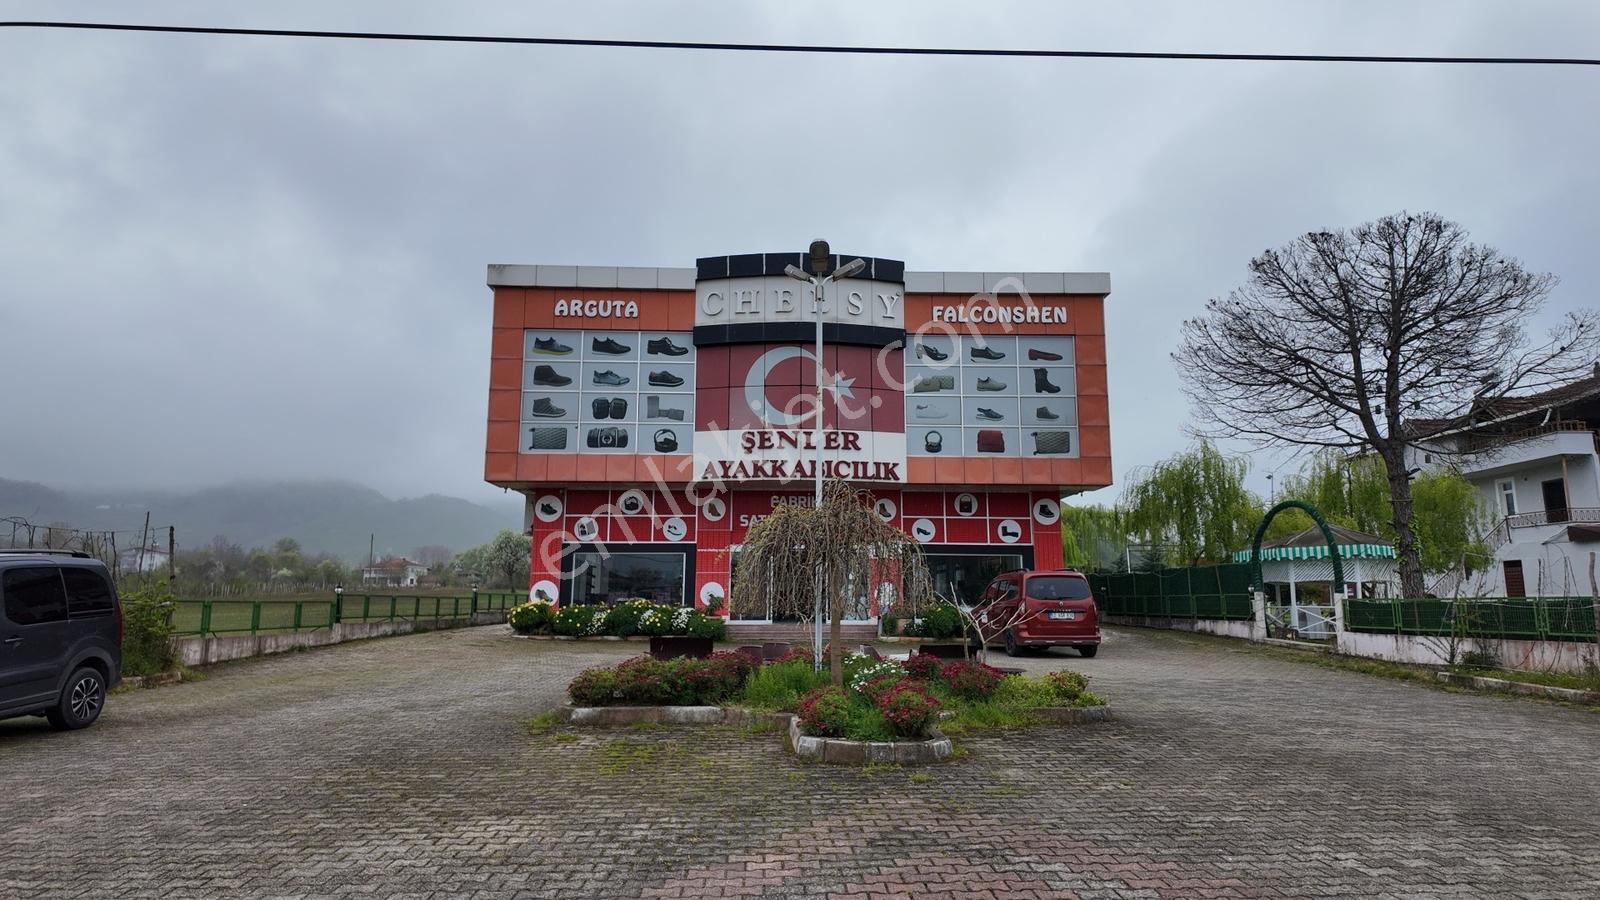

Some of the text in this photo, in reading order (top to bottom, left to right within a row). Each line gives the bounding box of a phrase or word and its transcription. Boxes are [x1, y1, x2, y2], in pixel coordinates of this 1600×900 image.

[554, 298, 640, 318] ARGUTA
[932, 305, 1068, 324] FALCONSHEN
[741, 430, 862, 454] ŞENLER
[702, 459, 900, 481] AYAKKABICILIK
